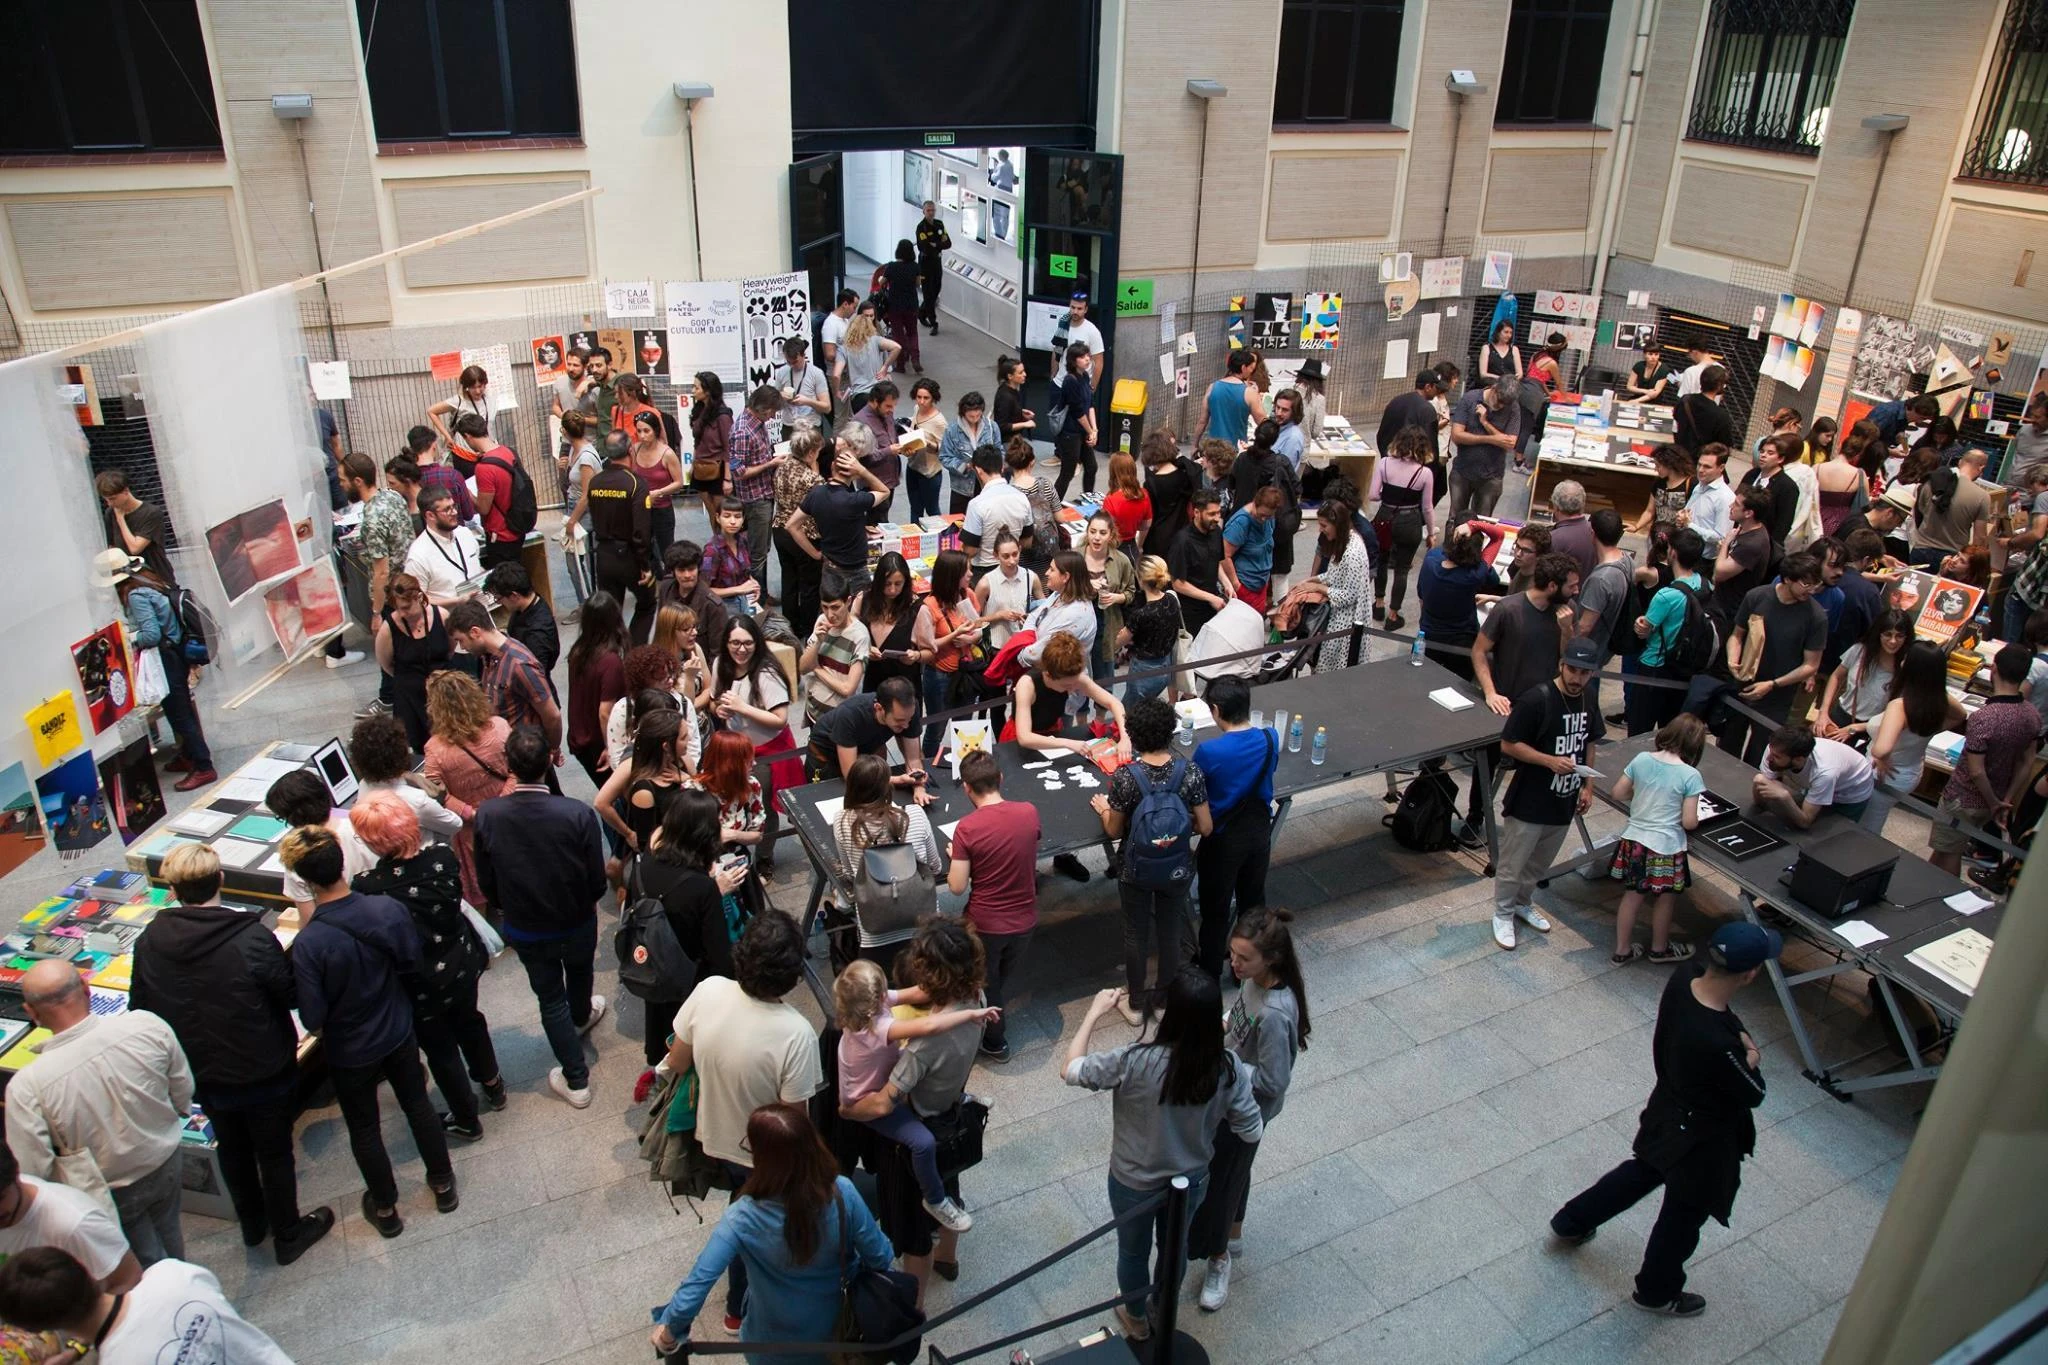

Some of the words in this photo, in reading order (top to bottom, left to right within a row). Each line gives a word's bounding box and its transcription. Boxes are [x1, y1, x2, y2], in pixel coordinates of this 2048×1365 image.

[743, 274, 798, 289] Heavyweight
[627, 289, 648, 298] CAJA
[743, 285, 787, 298] Collection
[1116, 300, 1149, 311] Salida
[691, 319, 716, 327] GOOFY
[670, 326, 706, 334] CUTULUM
[591, 489, 627, 498] PROSEGUR
[1924, 608, 1946, 620] ELVIS
[1563, 712, 1588, 734] THE
